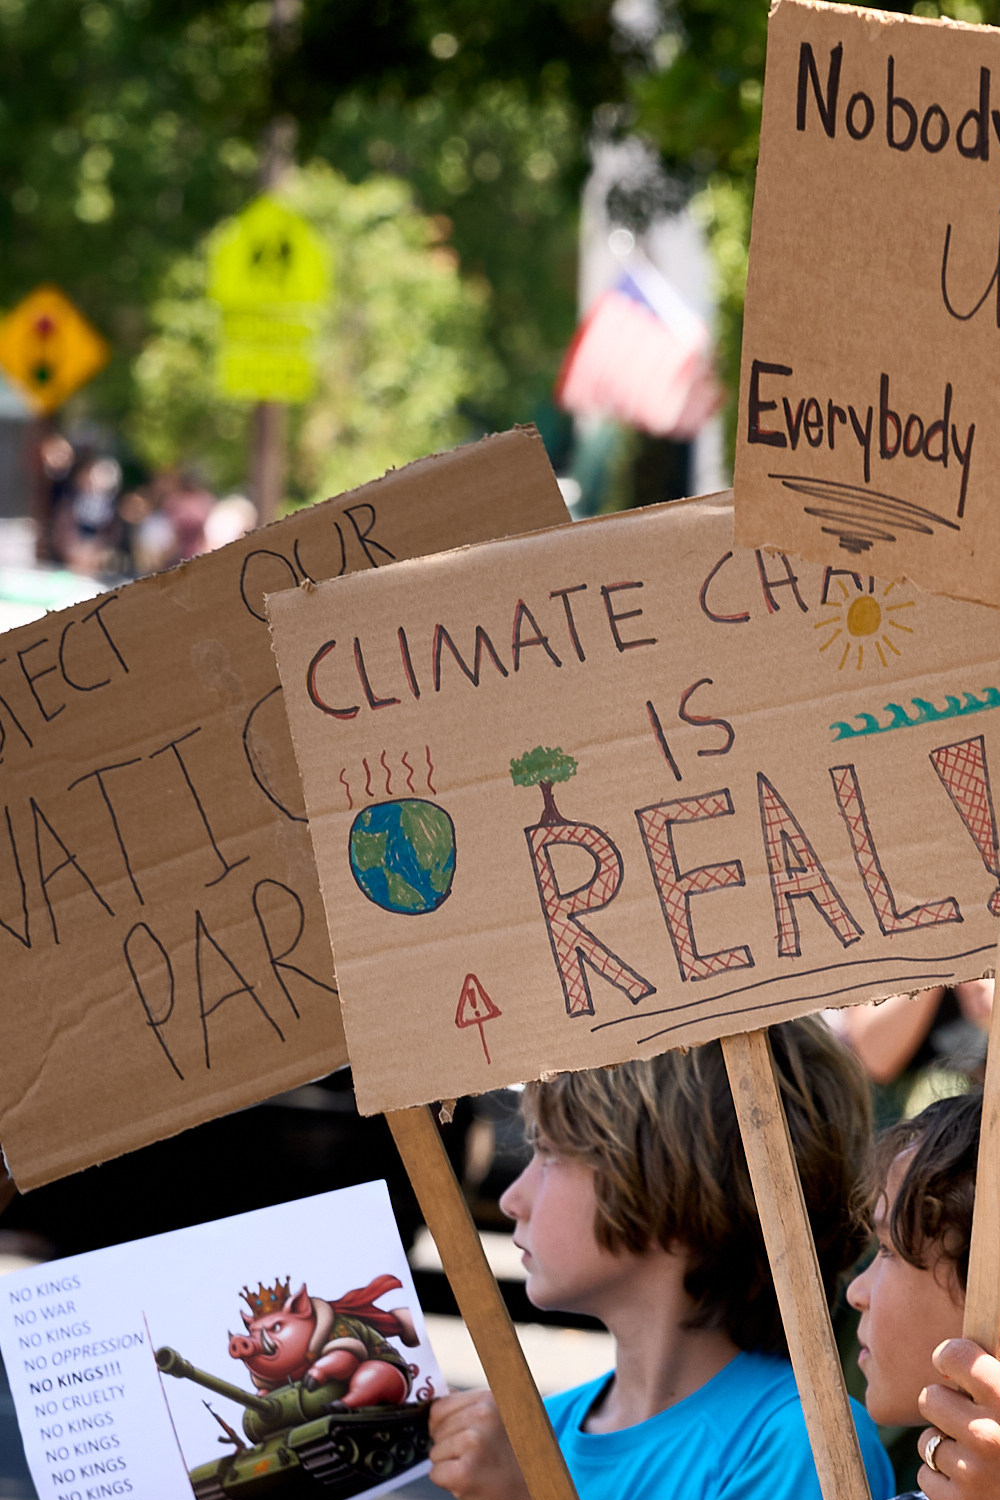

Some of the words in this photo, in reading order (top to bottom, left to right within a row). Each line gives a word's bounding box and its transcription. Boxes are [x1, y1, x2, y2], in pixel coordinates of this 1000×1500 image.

[747, 359, 975, 518] Everybody
[0, 596, 129, 764] TECT
[240, 504, 396, 623] OUR
[306, 582, 657, 720] CLIMATE
[646, 678, 734, 781] IS
[124, 879, 338, 1080] PAR
[10, 1287, 32, 1304] NO
[36, 1275, 81, 1297] KINGS
[14, 1310, 37, 1327] NO
[40, 1300, 77, 1321] WAR
[19, 1333, 41, 1349] NO
[46, 1320, 92, 1343] KINGS
[24, 1356, 47, 1372] NO
[52, 1331, 145, 1366] OPPRESSION
[30, 1378, 53, 1395] NO
[57, 1361, 121, 1388] KINGS!!!
[35, 1401, 58, 1418] NO
[62, 1385, 126, 1411] CRUELTY
[40, 1424, 63, 1440] NO
[68, 1412, 114, 1434] KINGS
[46, 1446, 69, 1463] NO
[74, 1434, 121, 1457] KINGS
[52, 1469, 75, 1485] NO
[80, 1456, 127, 1479] KINGS
